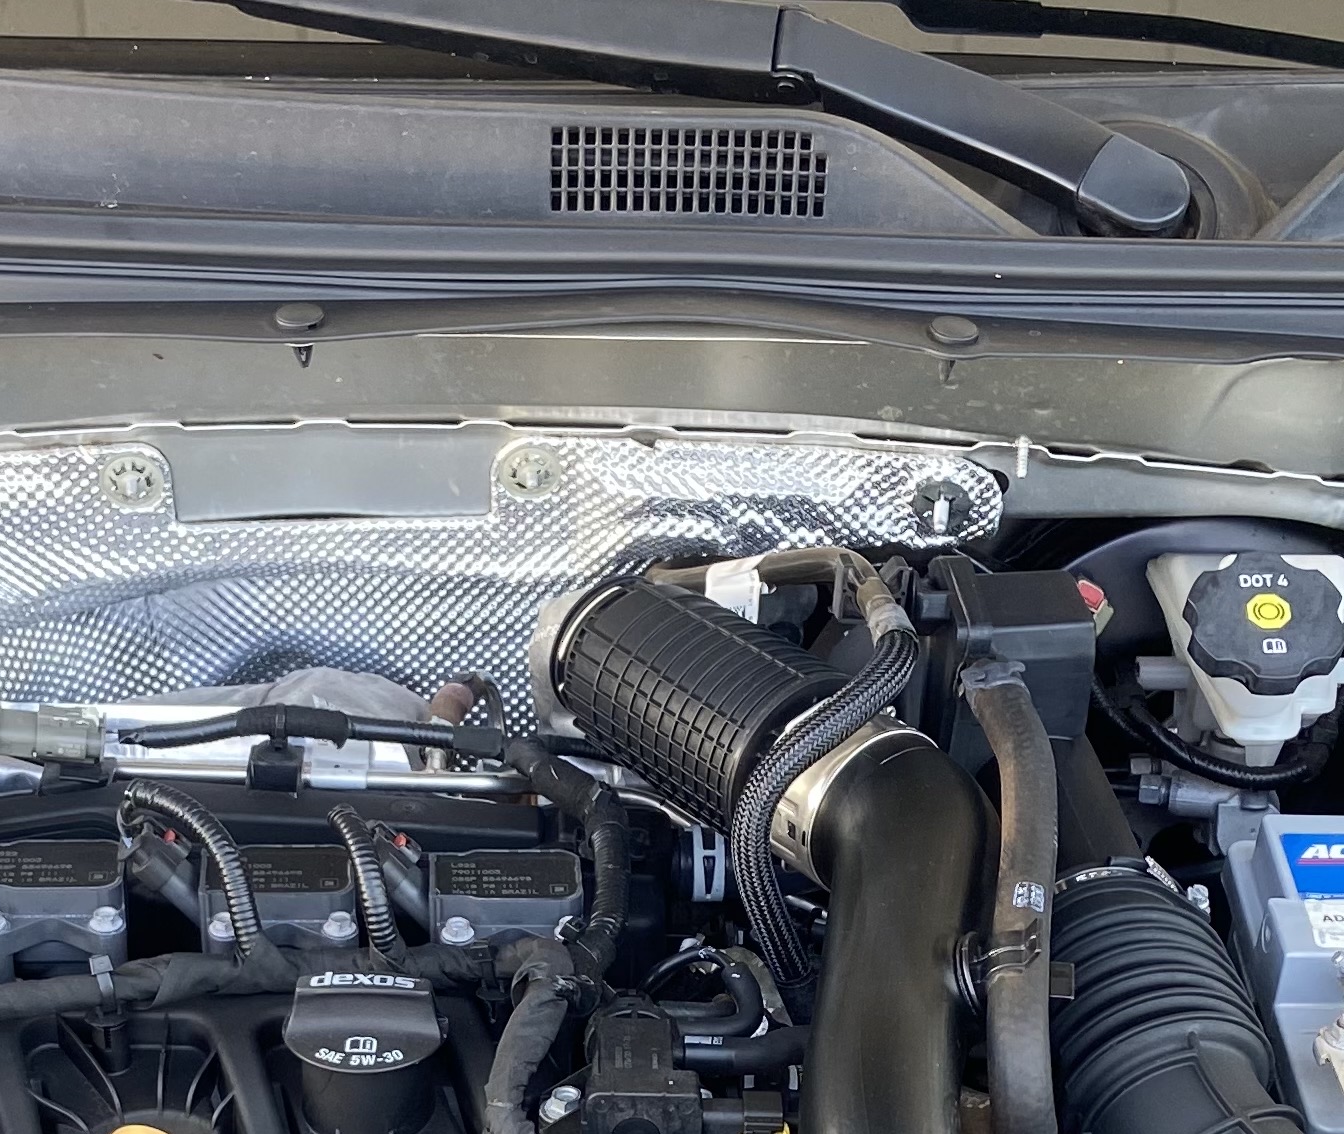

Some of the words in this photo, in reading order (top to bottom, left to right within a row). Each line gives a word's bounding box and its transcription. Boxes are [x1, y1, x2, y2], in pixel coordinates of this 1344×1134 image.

[1238, 573, 1274, 588] DOT
[1278, 573, 1289, 587] 4
[309, 971, 419, 989] dexos
[314, 1048, 346, 1064] SAE
[349, 1049, 405, 1066] 5W-30
